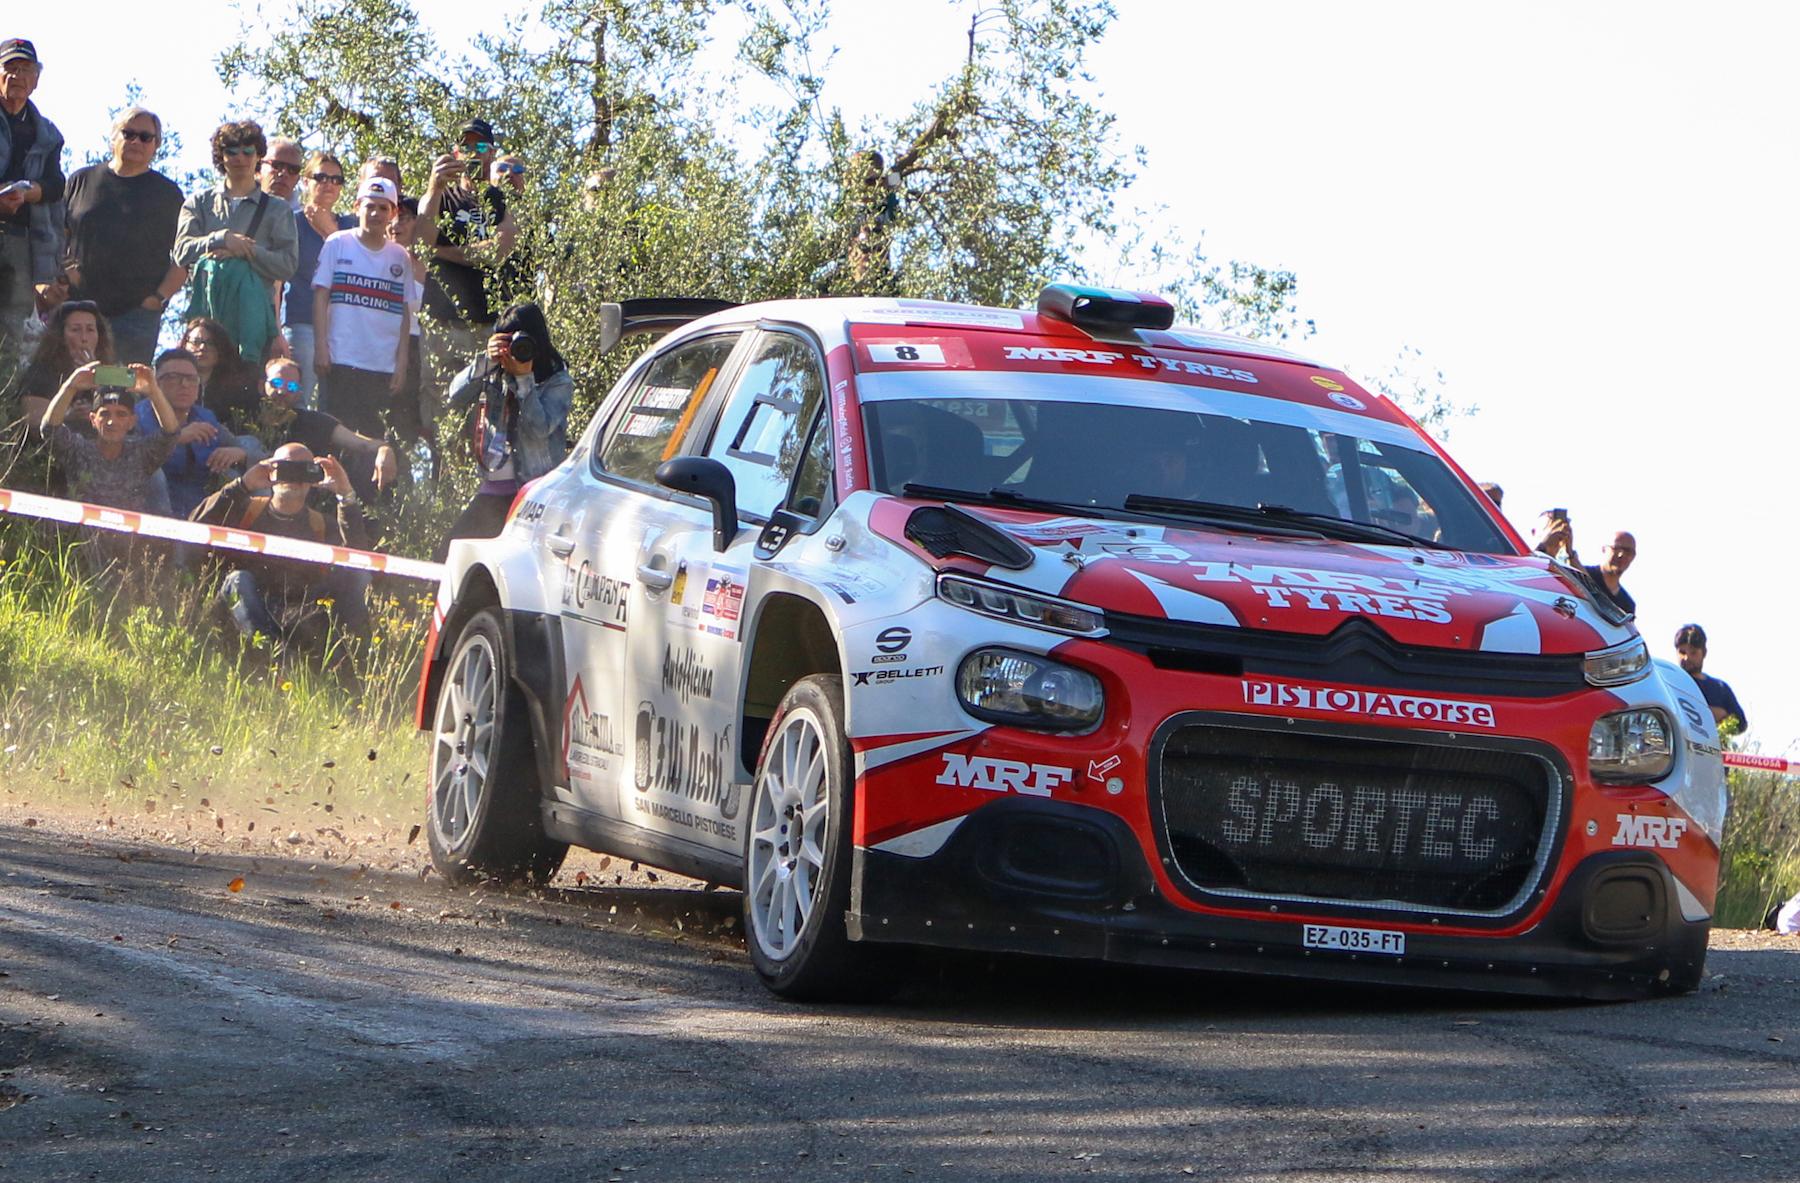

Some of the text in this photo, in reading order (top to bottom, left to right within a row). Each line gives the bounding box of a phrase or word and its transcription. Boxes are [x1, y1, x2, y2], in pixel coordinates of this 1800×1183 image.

[344, 293, 389, 309] RACING
[346, 275, 391, 291] MARTINI
[895, 346, 920, 361] 8
[1003, 346, 1258, 384] MRF TYRES
[1193, 560, 1472, 602] MRF
[1252, 584, 1454, 625] TYRES
[662, 642, 713, 704] Autofficina
[876, 665, 944, 679] BELLETTI
[935, 752, 1072, 798] MRF
[1725, 755, 1781, 769] PERICOLOSA
[634, 797, 737, 841] SAN MARCELLO PISTOIESE
[1221, 776, 1499, 861] SPORTEC
[1612, 814, 1687, 849] MRF
[1306, 926, 1403, 951] EZ-035-FT
